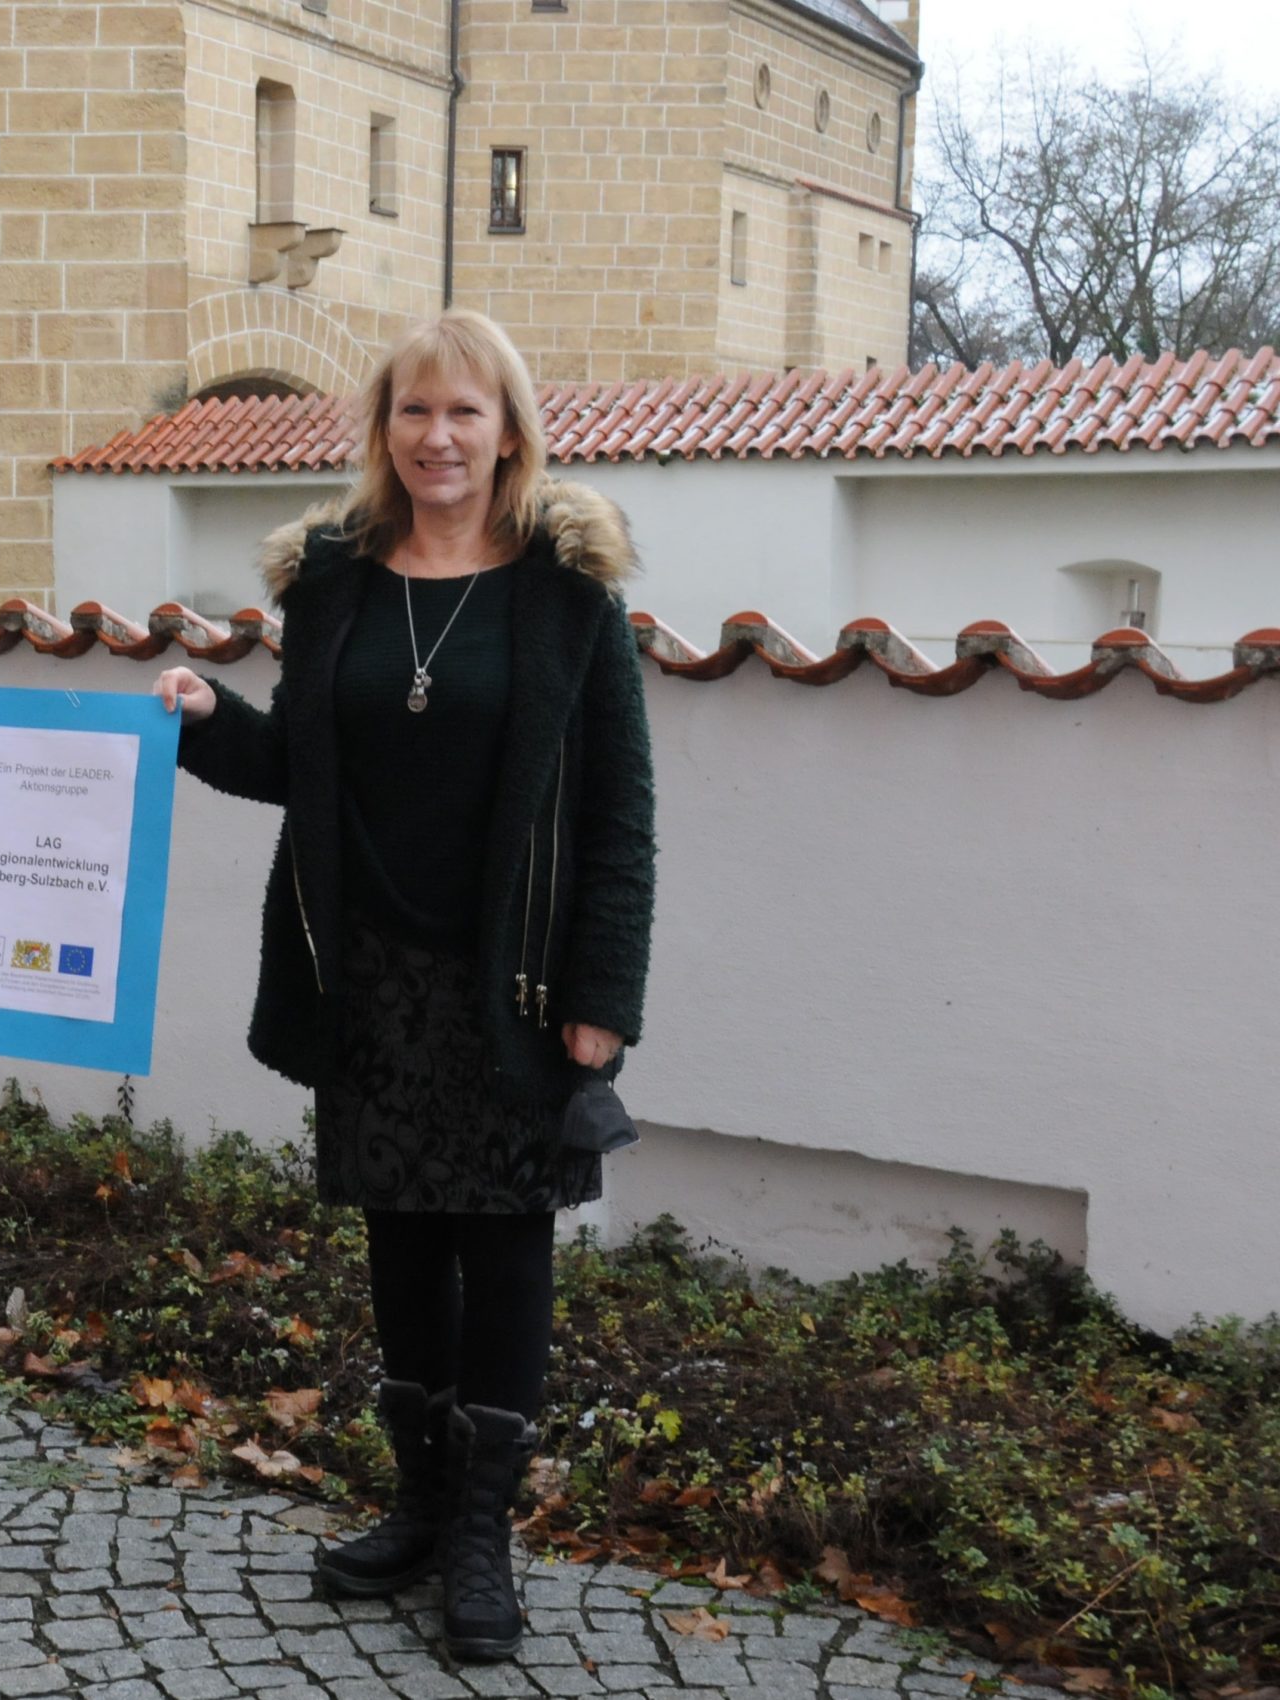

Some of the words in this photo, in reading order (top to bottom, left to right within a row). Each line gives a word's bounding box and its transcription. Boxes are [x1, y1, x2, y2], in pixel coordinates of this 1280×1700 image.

[15, 763, 49, 778] Projekt
[51, 767, 66, 778] der
[68, 767, 114, 781] LEADER-
[20, 780, 89, 797] Aktionsgruppe
[35, 836, 62, 850] LAG
[87, 879, 110, 893] e.V.
